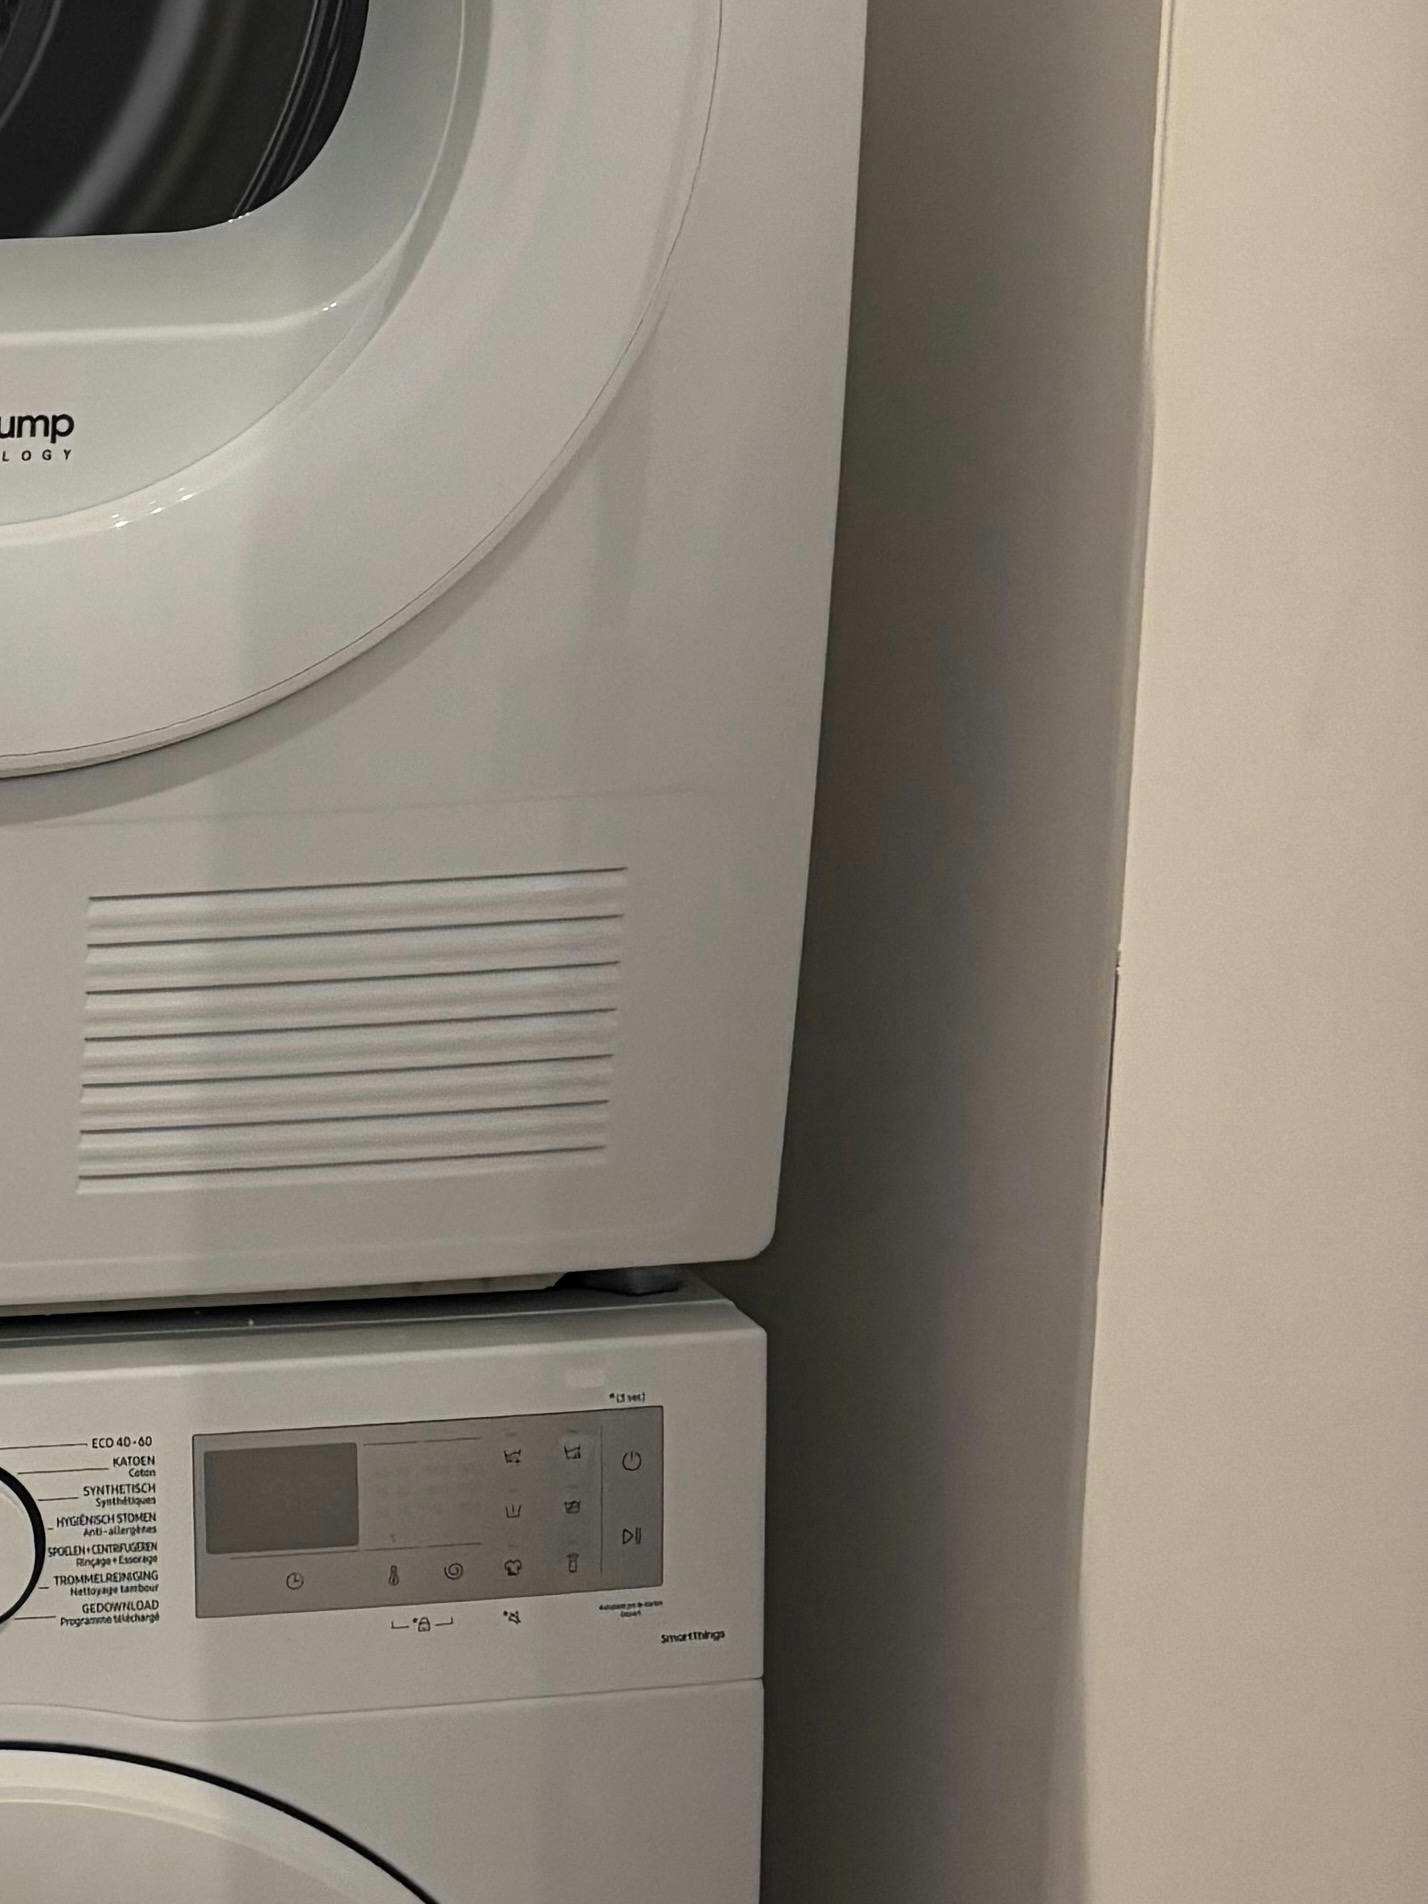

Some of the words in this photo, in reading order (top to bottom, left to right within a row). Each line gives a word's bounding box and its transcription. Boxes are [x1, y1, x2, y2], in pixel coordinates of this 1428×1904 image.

[91, 1437, 114, 1449] ECO
[112, 1455, 156, 1468] KATOEN
[82, 1482, 157, 1497] SYNTHETISCH
[115, 1511, 157, 1525] STOMEN
[81, 1599, 160, 1615] GEDOWNLOAD
[660, 1630, 726, 1644] SmartThings
